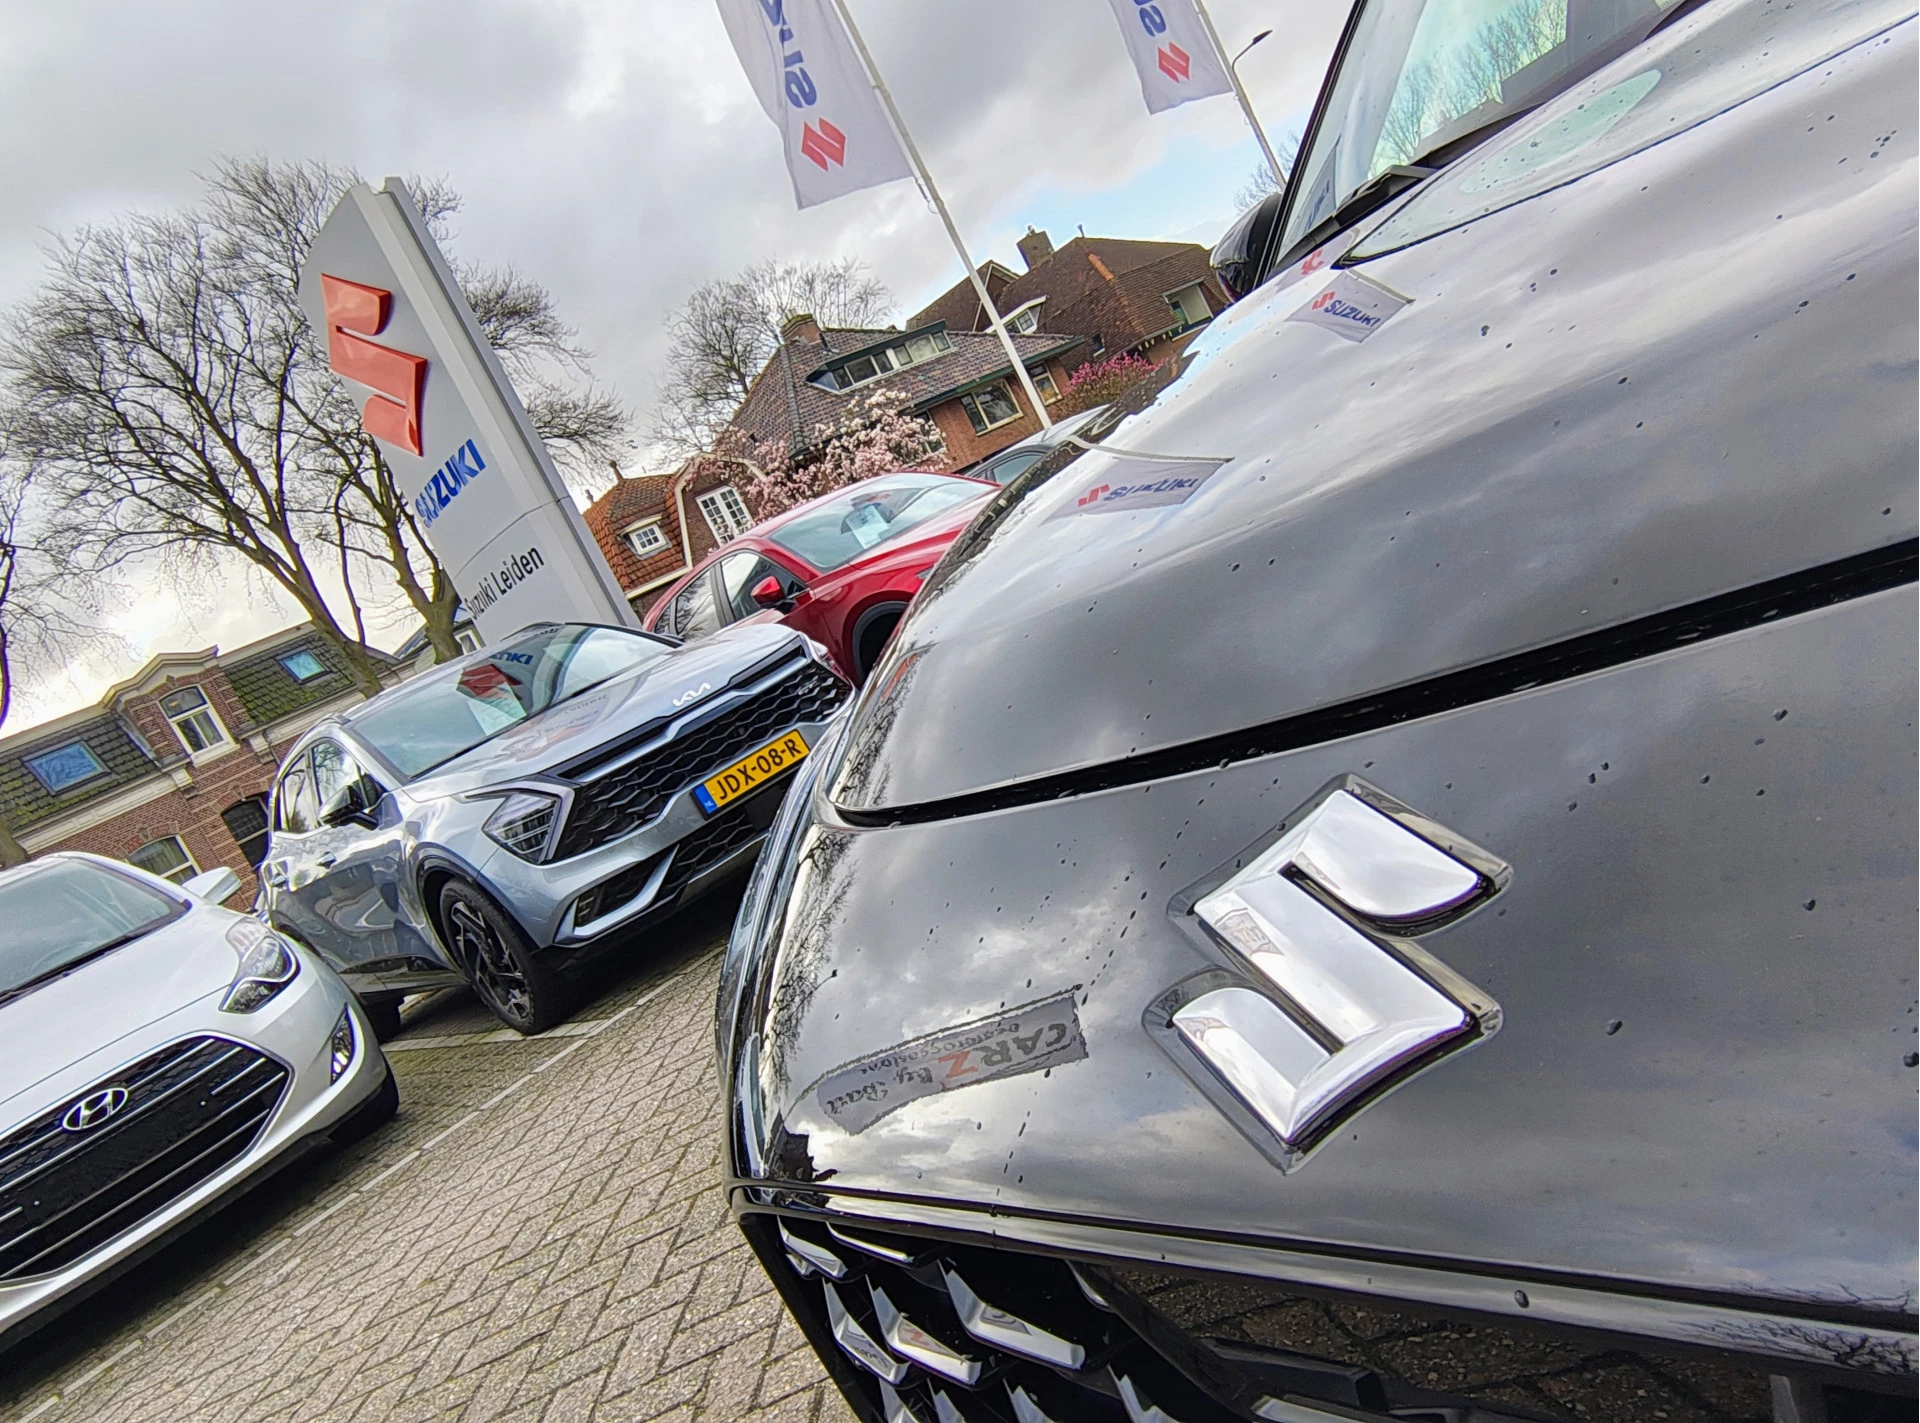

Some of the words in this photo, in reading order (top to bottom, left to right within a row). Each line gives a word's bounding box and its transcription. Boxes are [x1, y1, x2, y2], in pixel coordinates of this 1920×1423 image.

[1323, 299, 1381, 328] SUZUKI
[415, 438, 487, 528] SUZUKI
[464, 577, 498, 620] Suzuki
[490, 547, 544, 595] Leiden
[714, 738, 802, 800] JDX-08-R
[938, 1023, 1067, 1078] CARZ
